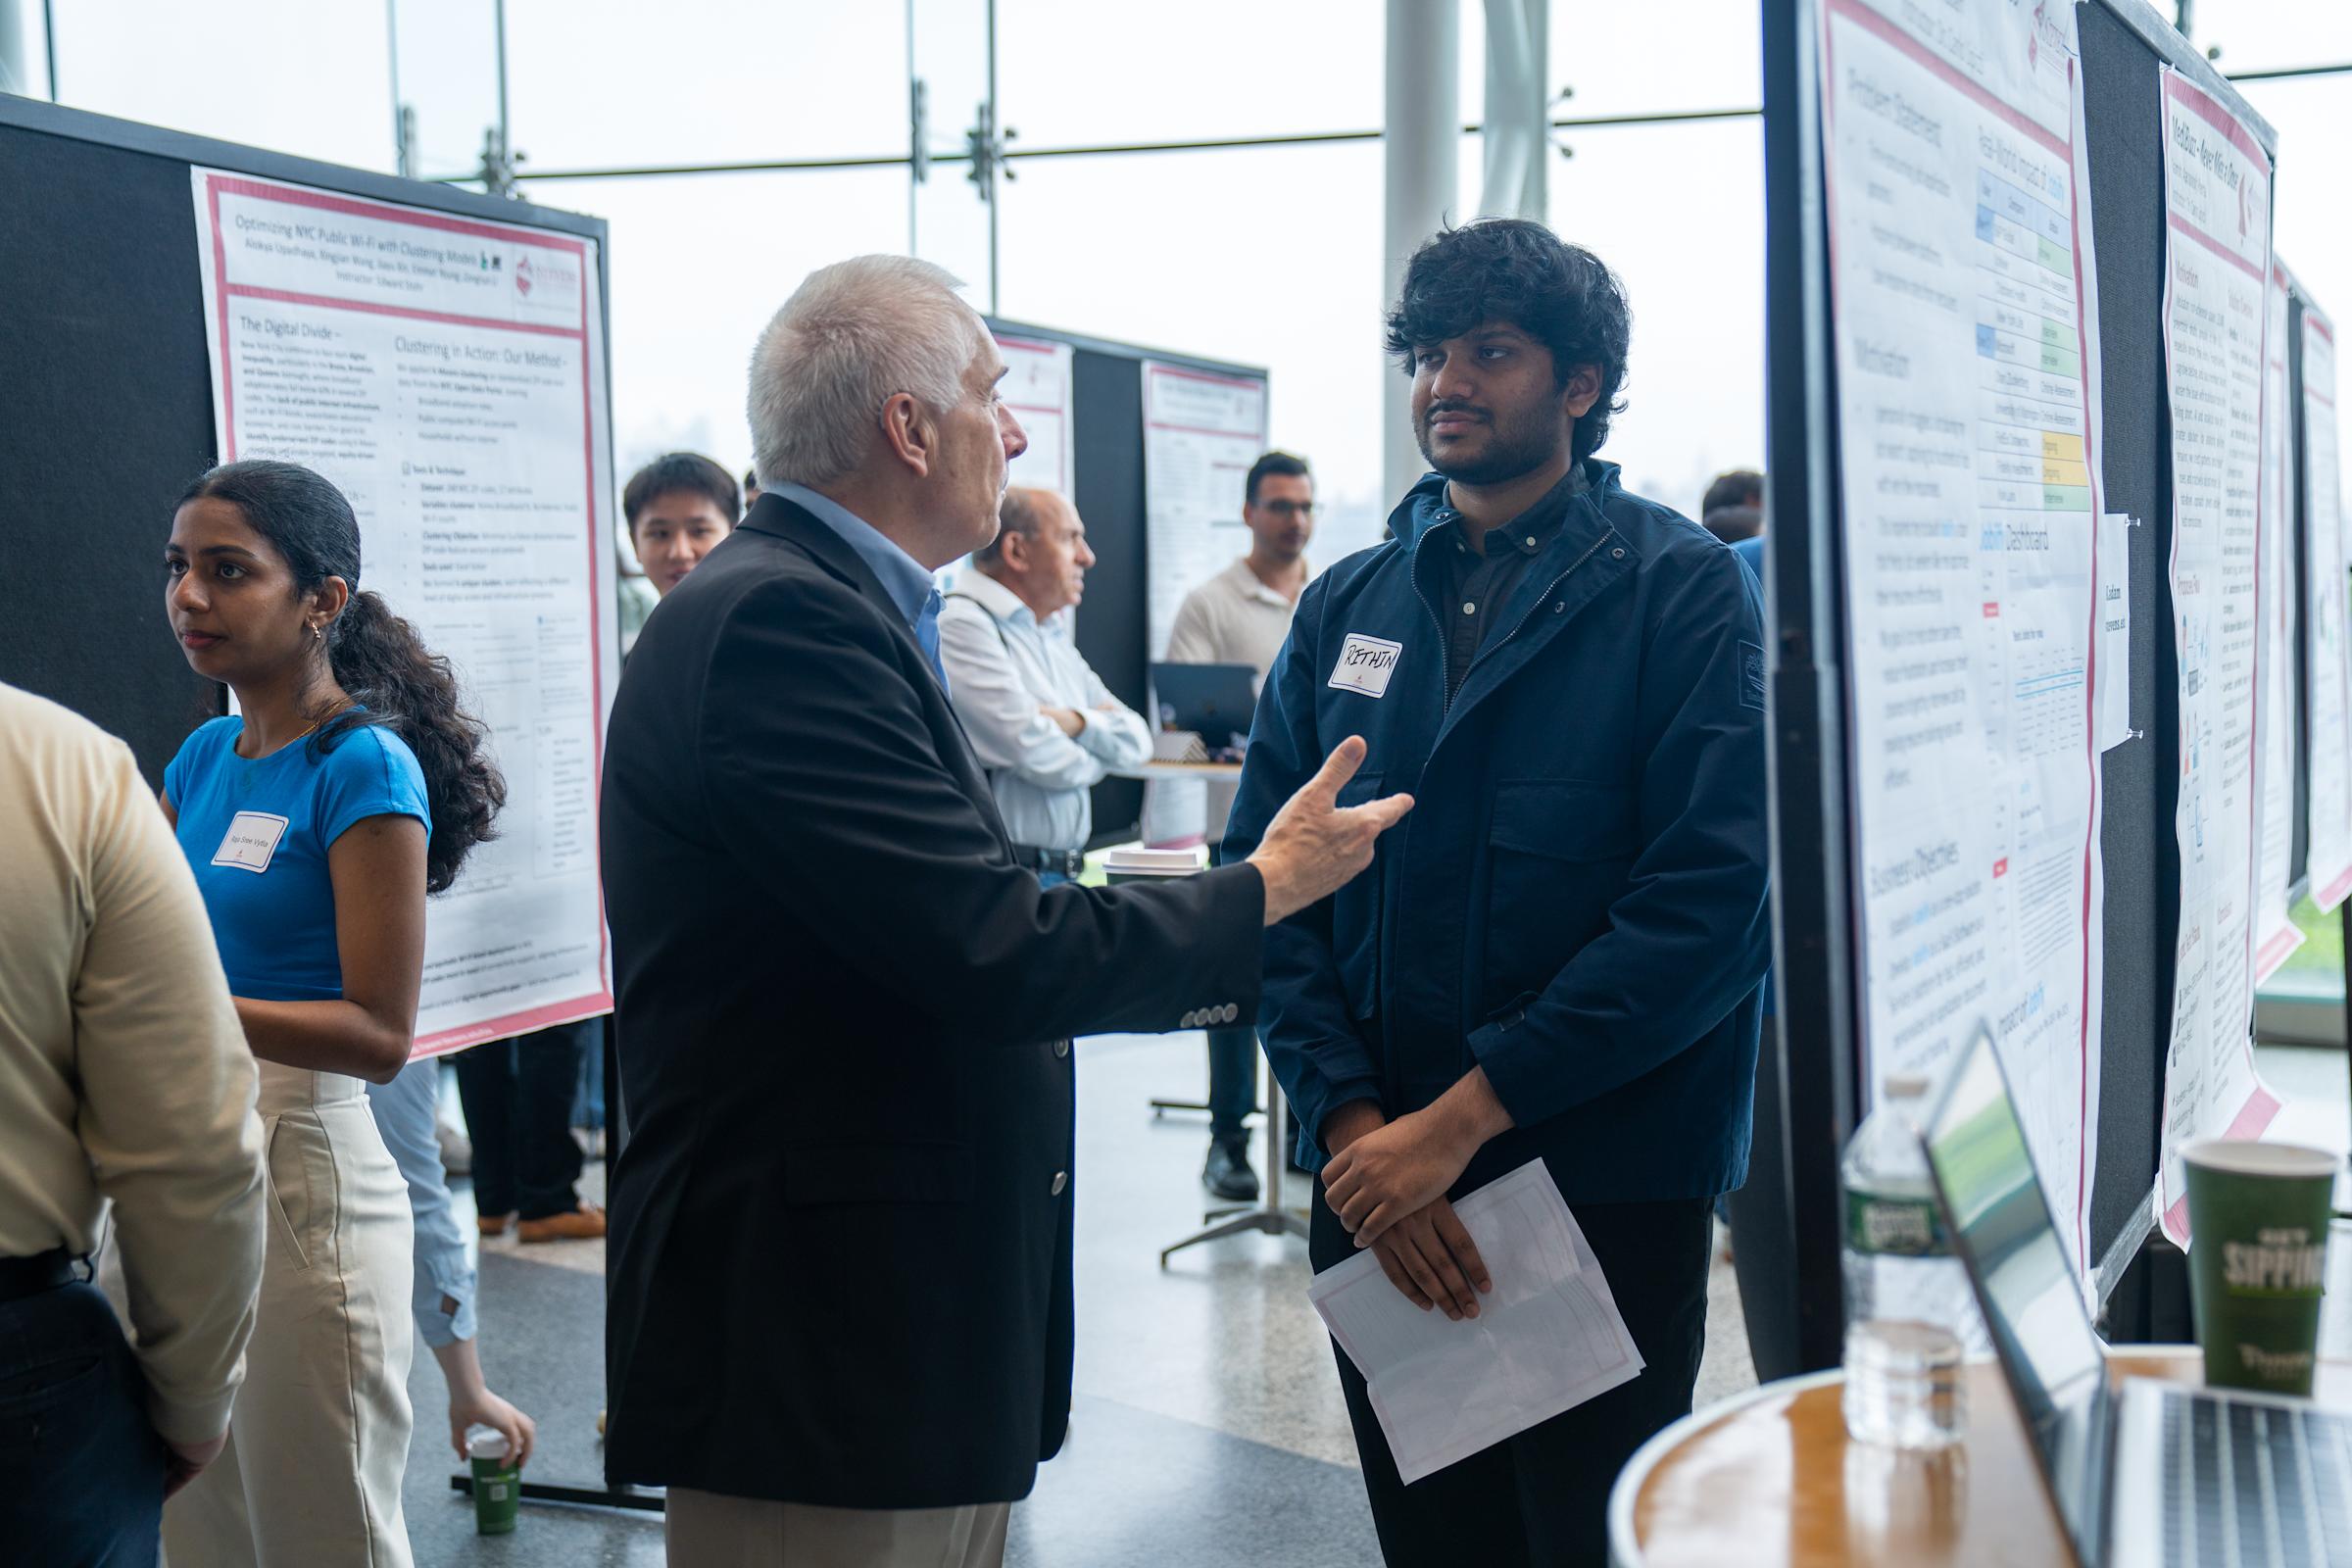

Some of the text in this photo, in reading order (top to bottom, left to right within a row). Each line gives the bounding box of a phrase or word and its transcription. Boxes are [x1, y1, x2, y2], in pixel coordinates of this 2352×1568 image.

[235, 214, 292, 239] Optimizing
[295, 223, 315, 241] NYC
[318, 228, 346, 245] Public
[350, 234, 375, 250] Wi-Fi
[378, 239, 399, 252] with
[401, 241, 444, 265] Clustering
[241, 315, 262, 332] The
[265, 318, 300, 338] Digital
[302, 322, 332, 340] Divide
[395, 335, 451, 361] Clustering
[503, 348, 523, 364] Our
[525, 351, 562, 368] Method
